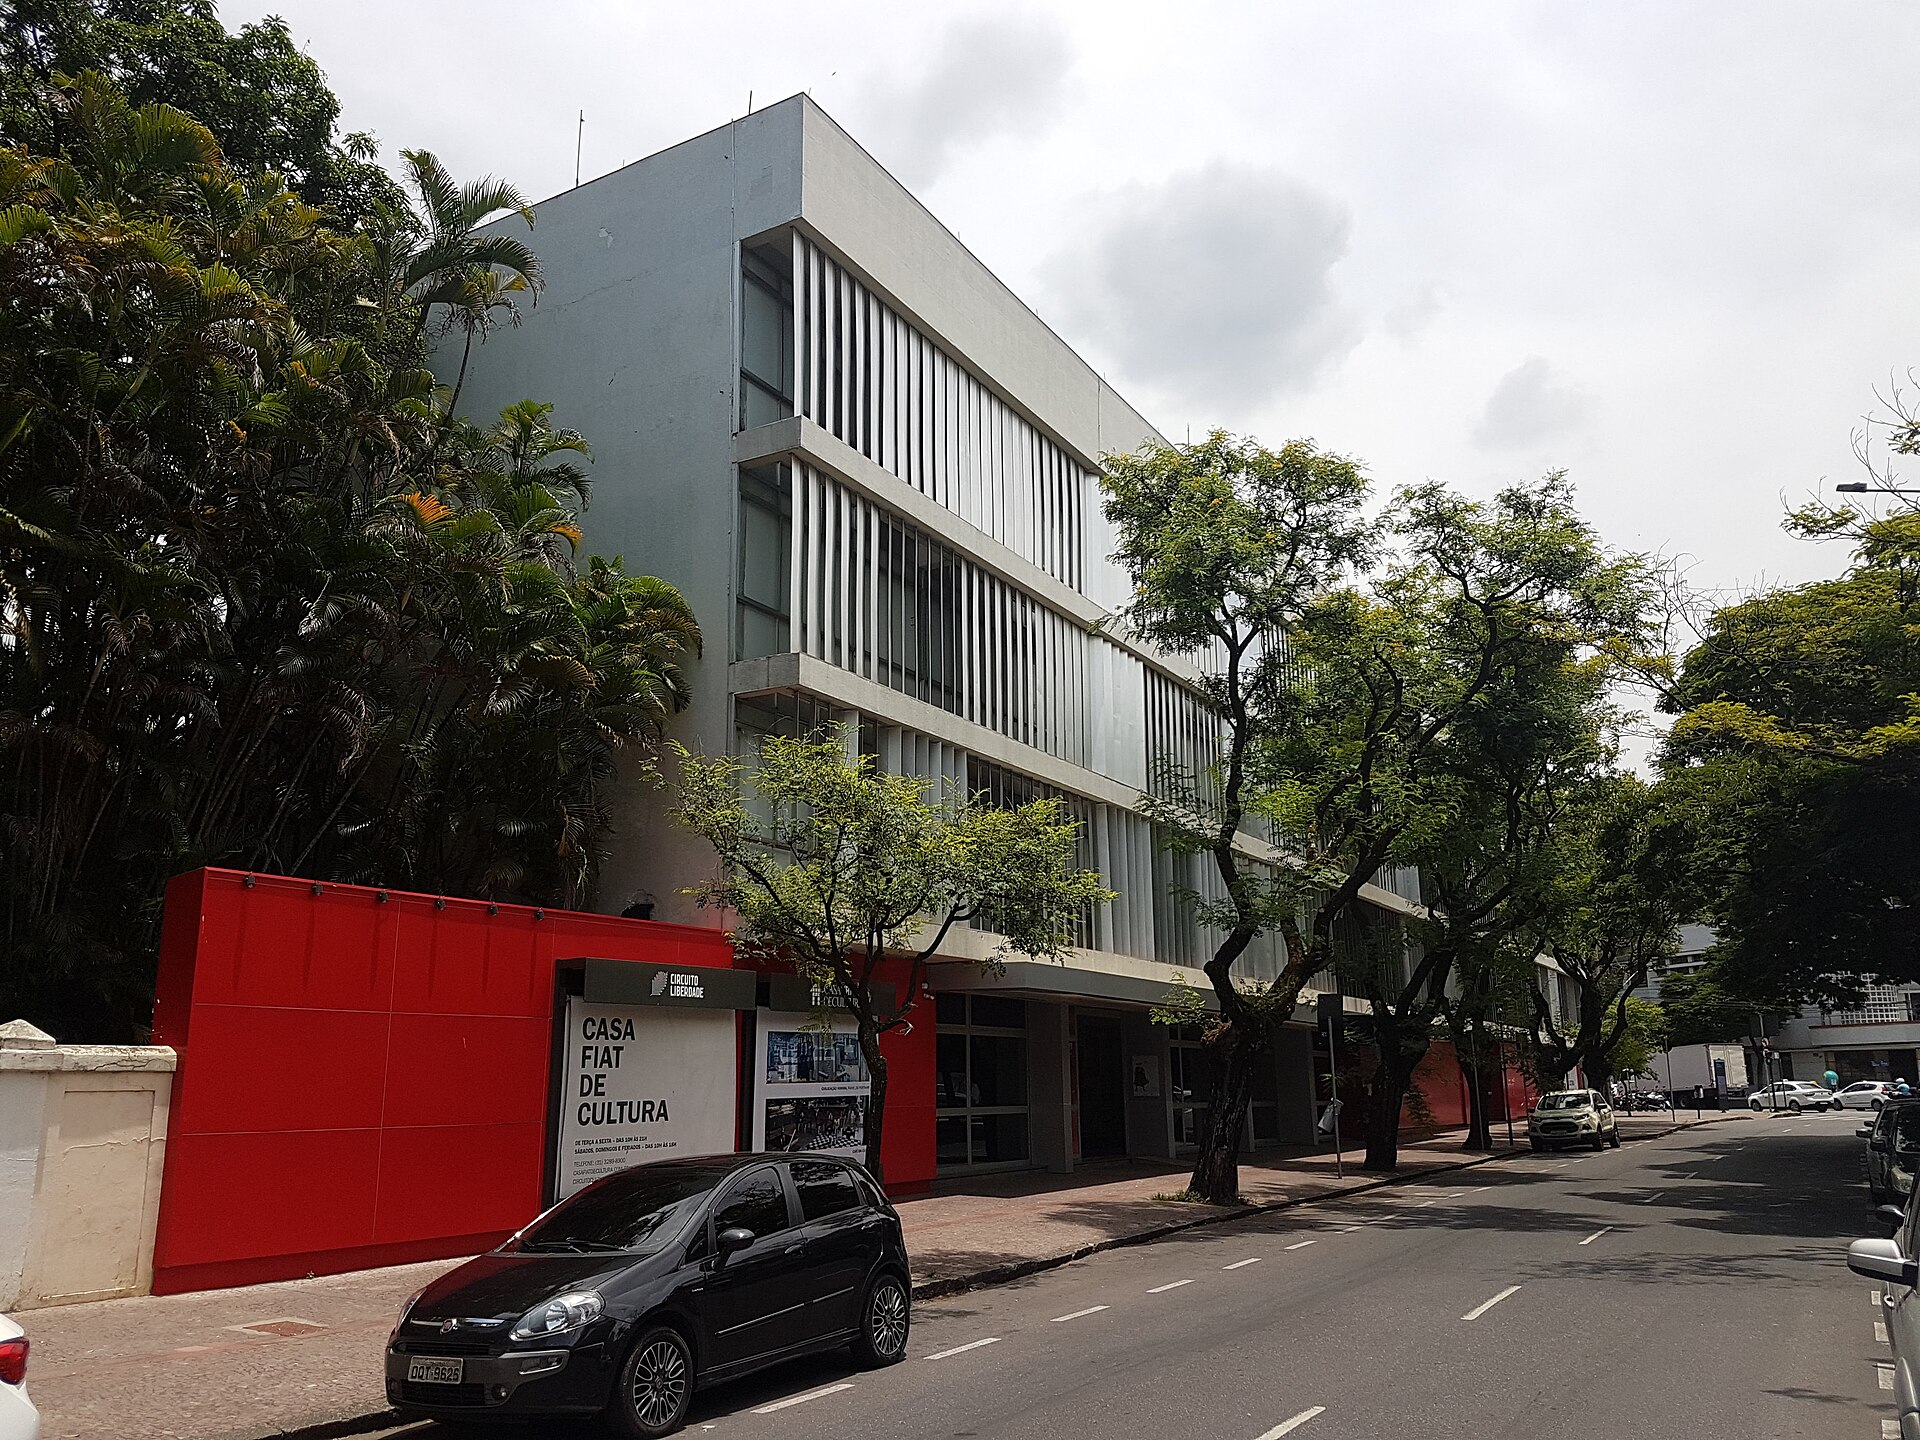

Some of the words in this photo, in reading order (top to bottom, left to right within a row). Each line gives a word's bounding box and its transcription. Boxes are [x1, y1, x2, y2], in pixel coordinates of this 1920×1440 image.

[670, 973, 699, 986] CIRCUITO
[670, 985, 704, 999] LIBERDADE
[582, 1017, 635, 1041] CASA
[581, 1045, 624, 1069] FIAT
[579, 1073, 607, 1097] DE
[577, 1099, 669, 1126] CULTURA
[581, 1139, 594, 1147] TERÇA
